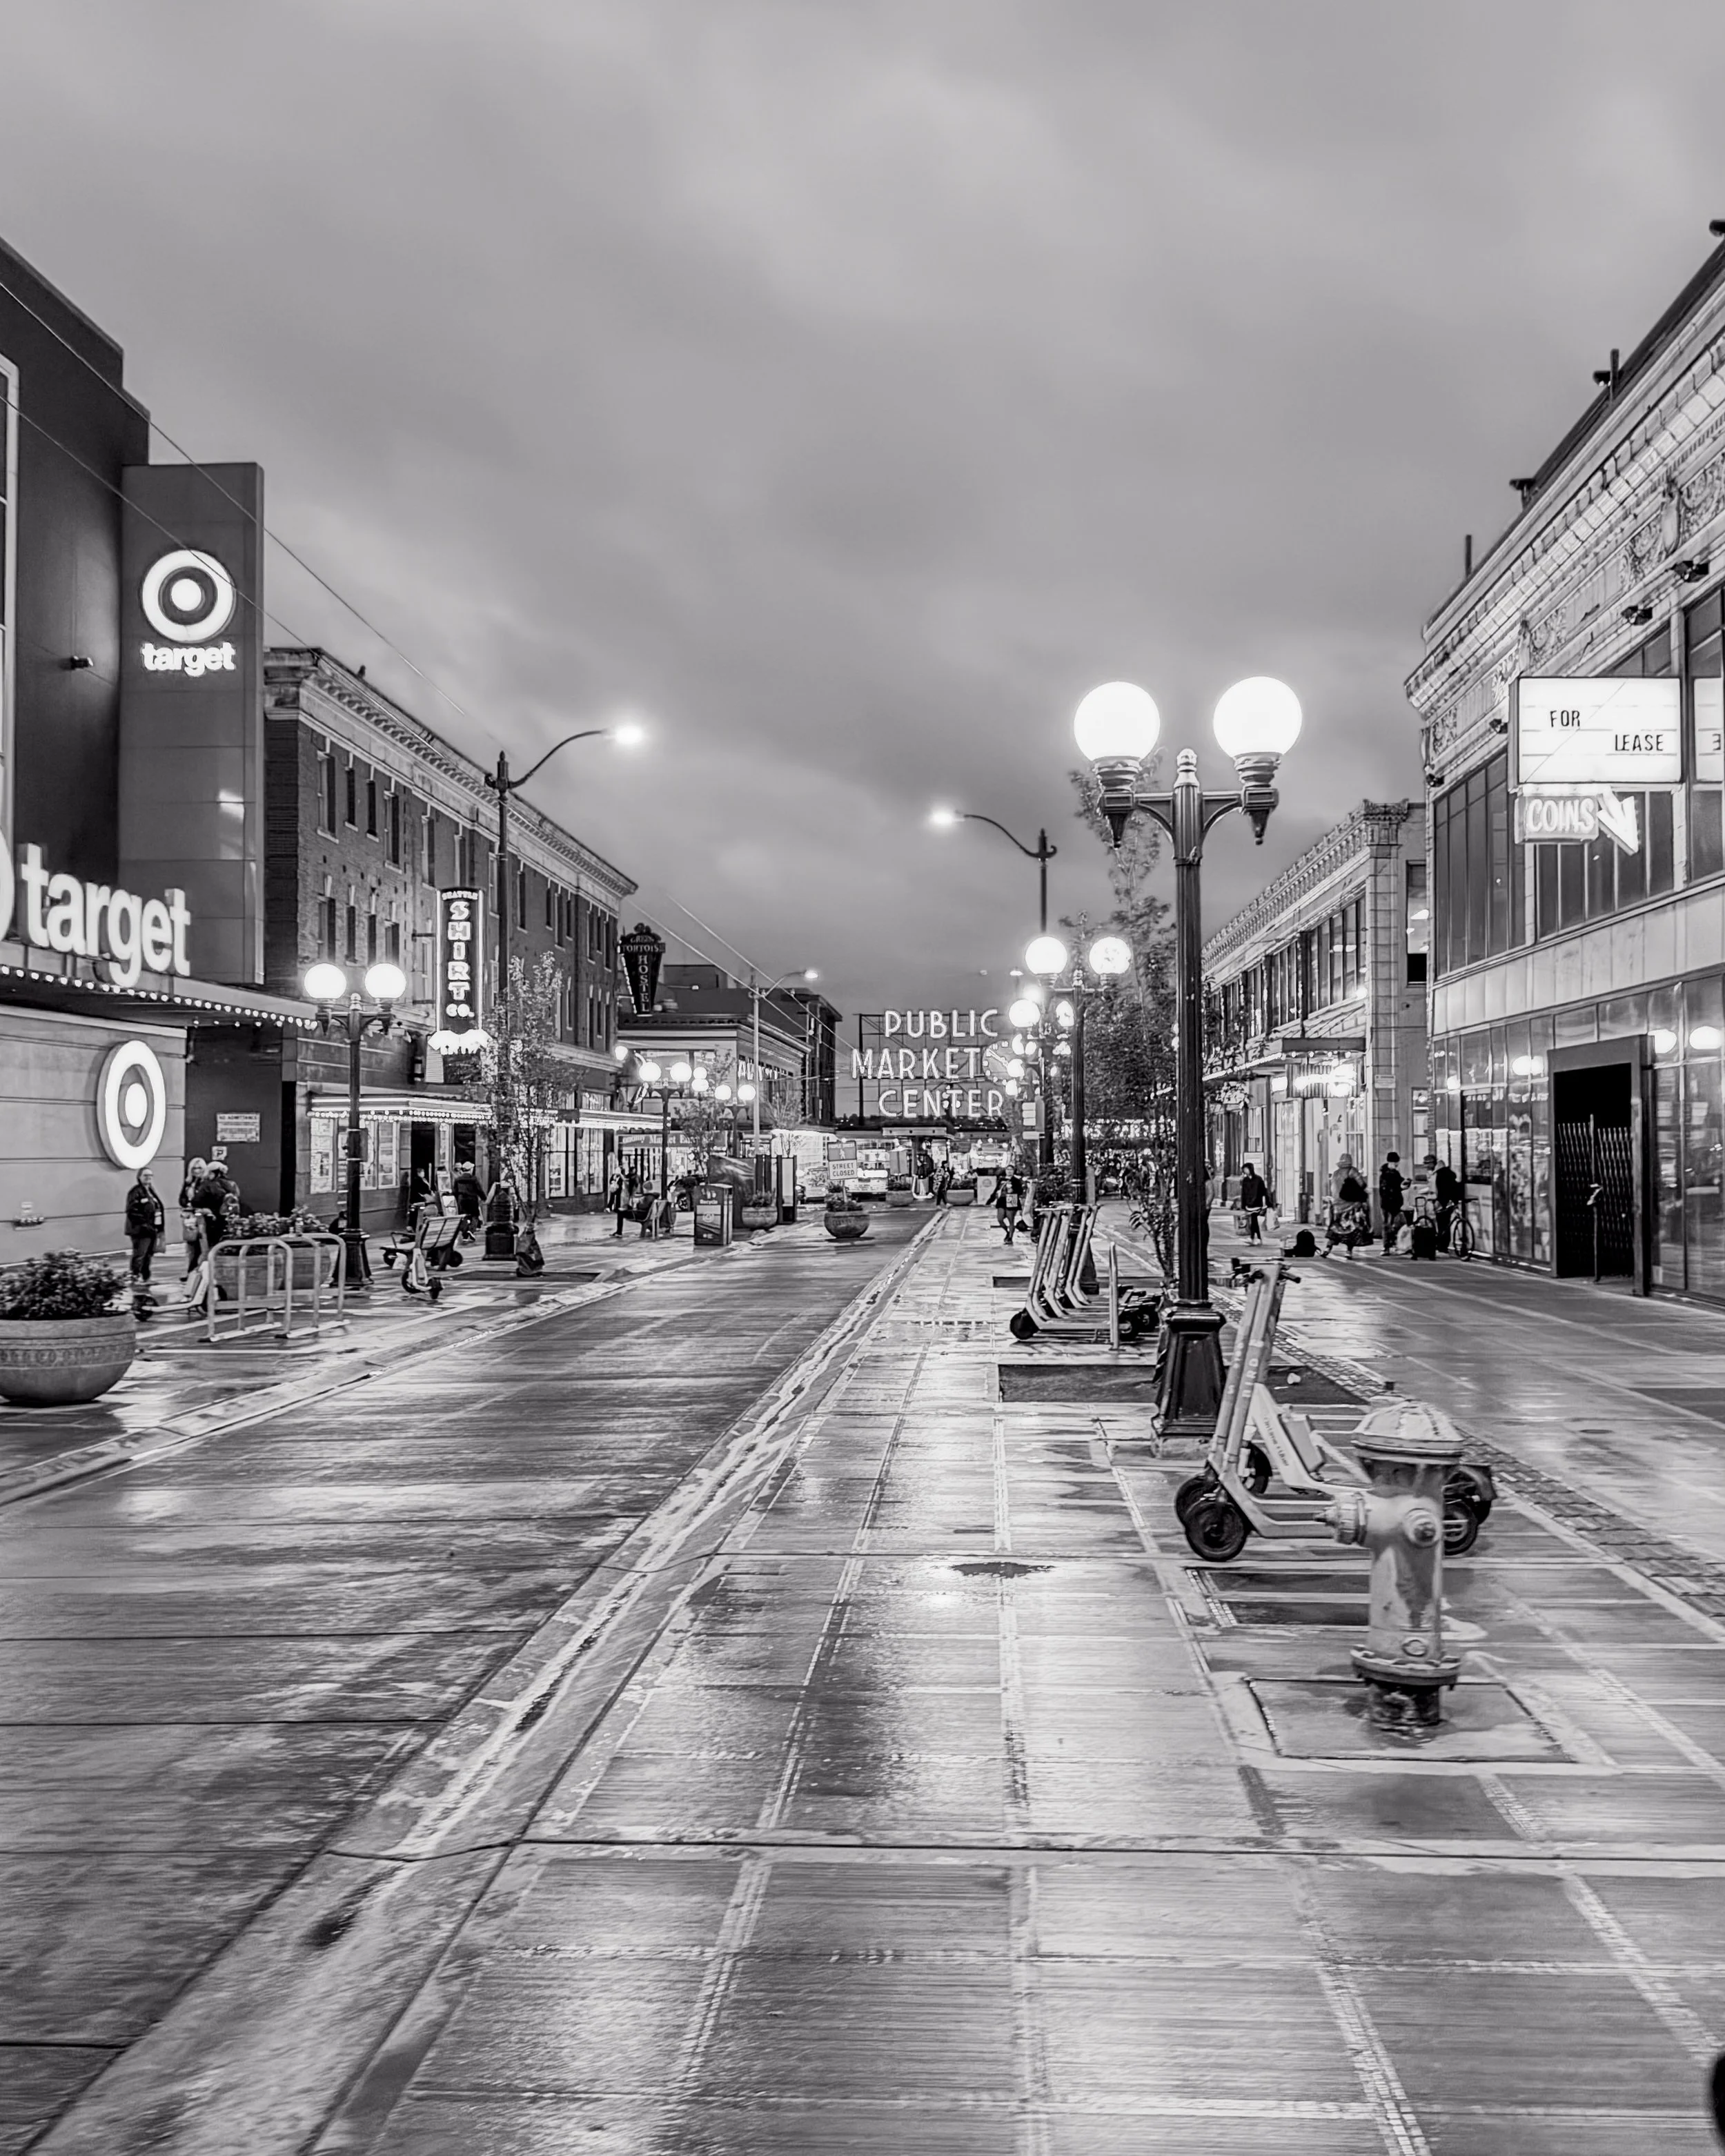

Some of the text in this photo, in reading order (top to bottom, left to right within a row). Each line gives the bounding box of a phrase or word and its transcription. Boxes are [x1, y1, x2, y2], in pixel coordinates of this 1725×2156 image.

[141, 642, 236, 677] target
[1550, 711, 1580, 727] FOR
[1615, 734, 1664, 751] LEASE
[1528, 797, 1595, 832] COINS
[442, 891, 478, 900] SEATTLE
[21, 843, 190, 988] target
[448, 900, 471, 1000] SHIRT
[639, 955, 649, 1012] HOSTEL
[446, 1003, 475, 1018] CO.
[885, 1009, 998, 1038] PUBLIC
[852, 1048, 980, 1079] MARKET
[878, 1089, 1003, 1118] CENTER
